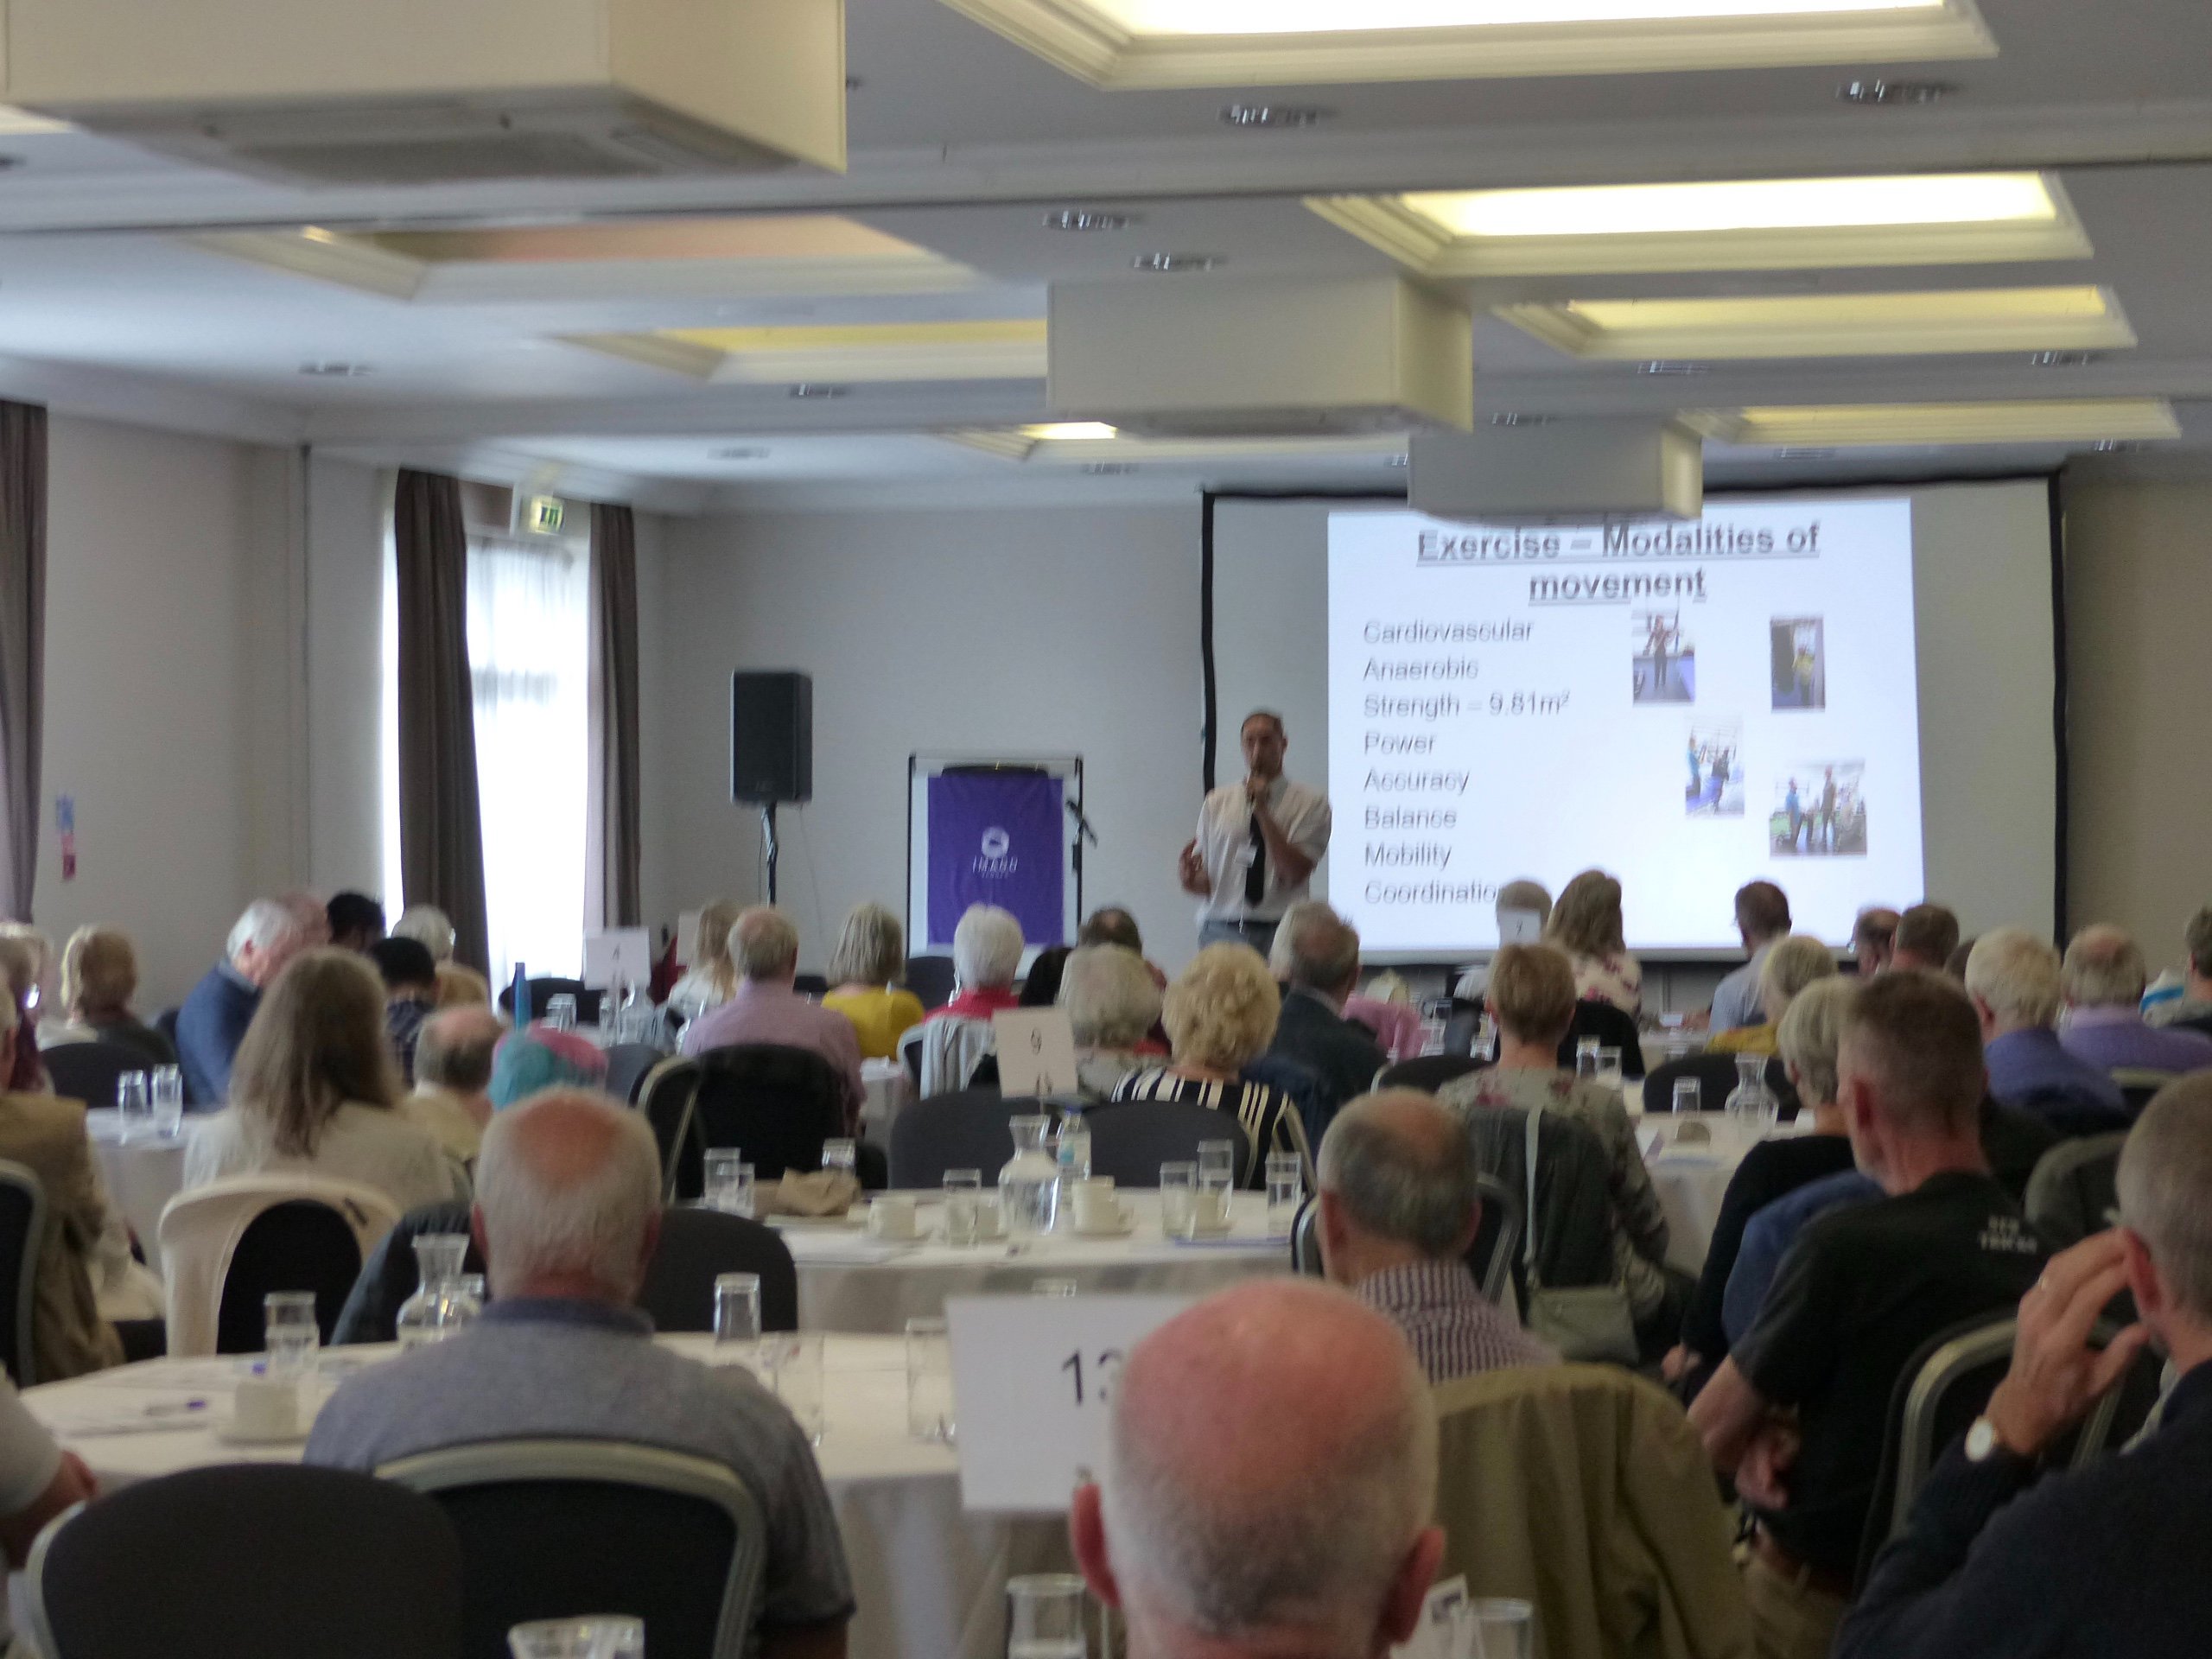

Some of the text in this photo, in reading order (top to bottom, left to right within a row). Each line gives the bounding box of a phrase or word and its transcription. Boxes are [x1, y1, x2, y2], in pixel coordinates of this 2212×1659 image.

[1417, 525, 1560, 561] Exercise
[1603, 520, 1775, 556] Modalities
[1786, 519, 1820, 553] of
[1529, 567, 1707, 600] movement
[1363, 618, 1535, 644] Cardiovascular
[1363, 656, 1478, 681] Anaerobic
[1363, 692, 1460, 721] Strength
[1363, 730, 1436, 755] Power
[1363, 766, 1470, 796] Accuracy
[1363, 804, 1458, 830] Balance
[1363, 842, 1452, 871] Mobility
[1363, 880, 1501, 905] Coordinatio
